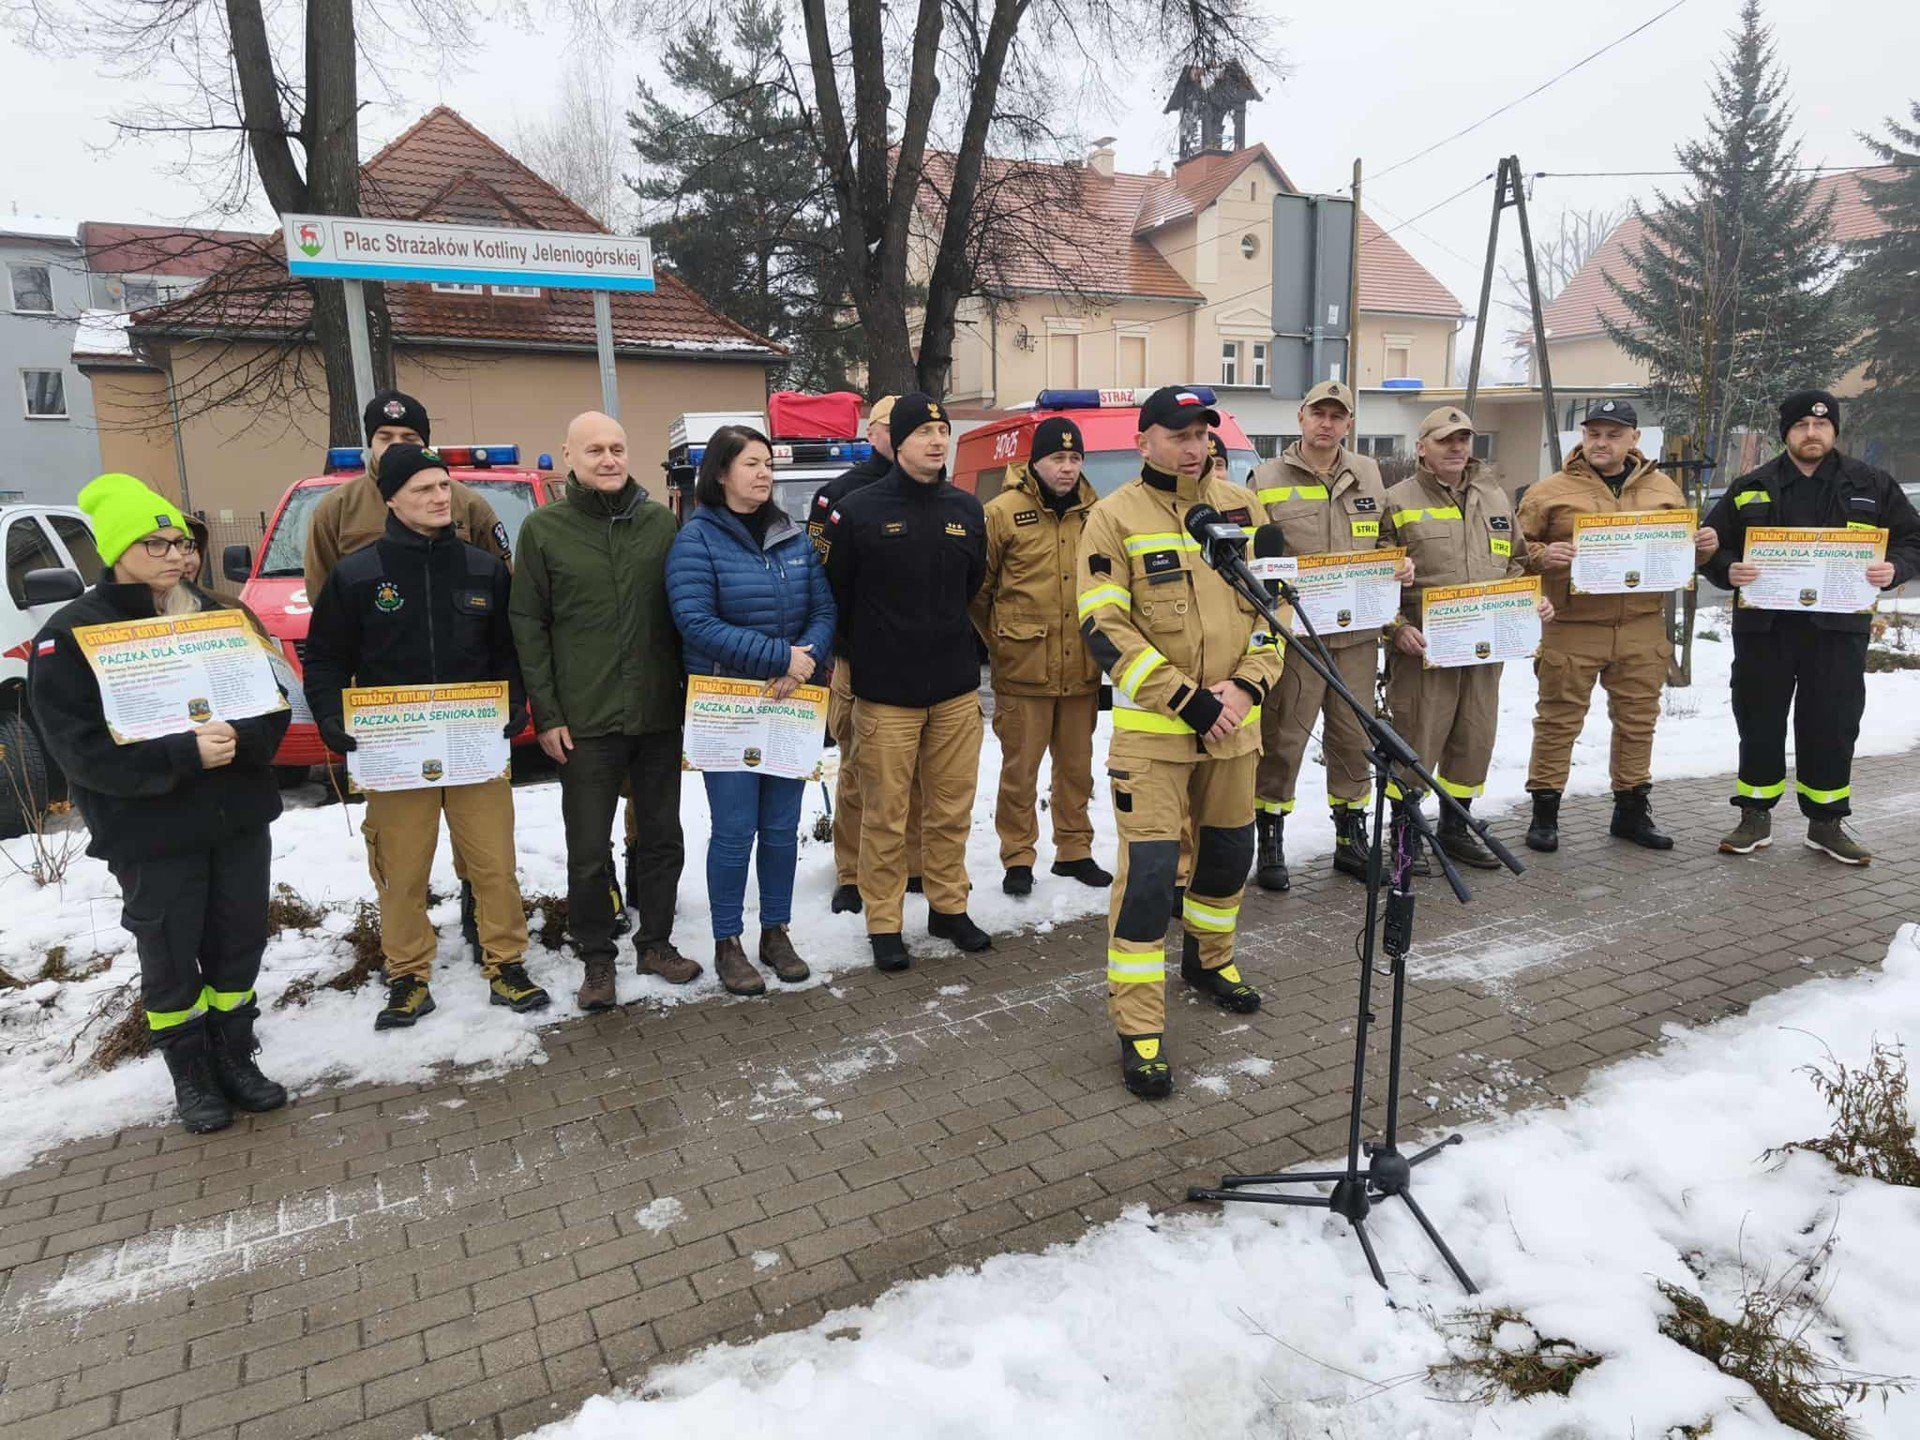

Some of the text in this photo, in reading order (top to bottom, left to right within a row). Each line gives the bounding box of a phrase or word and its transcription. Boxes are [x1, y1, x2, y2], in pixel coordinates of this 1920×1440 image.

[343, 231, 641, 271] Plac Strażaków Kotliny Jeleniogórskiej
[1579, 533, 1612, 541] PACZKA
[1634, 531, 1670, 540] SENIORA
[1750, 549, 1787, 557] PACZKA
[1790, 549, 1810, 557] DLA
[1812, 549, 1853, 558] SENIORA
[1345, 569, 1378, 579] SENIORA
[1428, 607, 1460, 616] PACZKA
[1463, 604, 1479, 612] DLA
[1481, 601, 1516, 611] SENIORA
[98, 651, 149, 667] PACZKA
[151, 647, 175, 659] DLA
[178, 639, 226, 654] SENIORA
[693, 701, 731, 713] PACZKA
[735, 704, 754, 714] DLA
[756, 706, 795, 716] SENIORA
[354, 714, 399, 726] PACZKA
[403, 712, 426, 723] DLA
[429, 709, 476, 721] SENIORA
